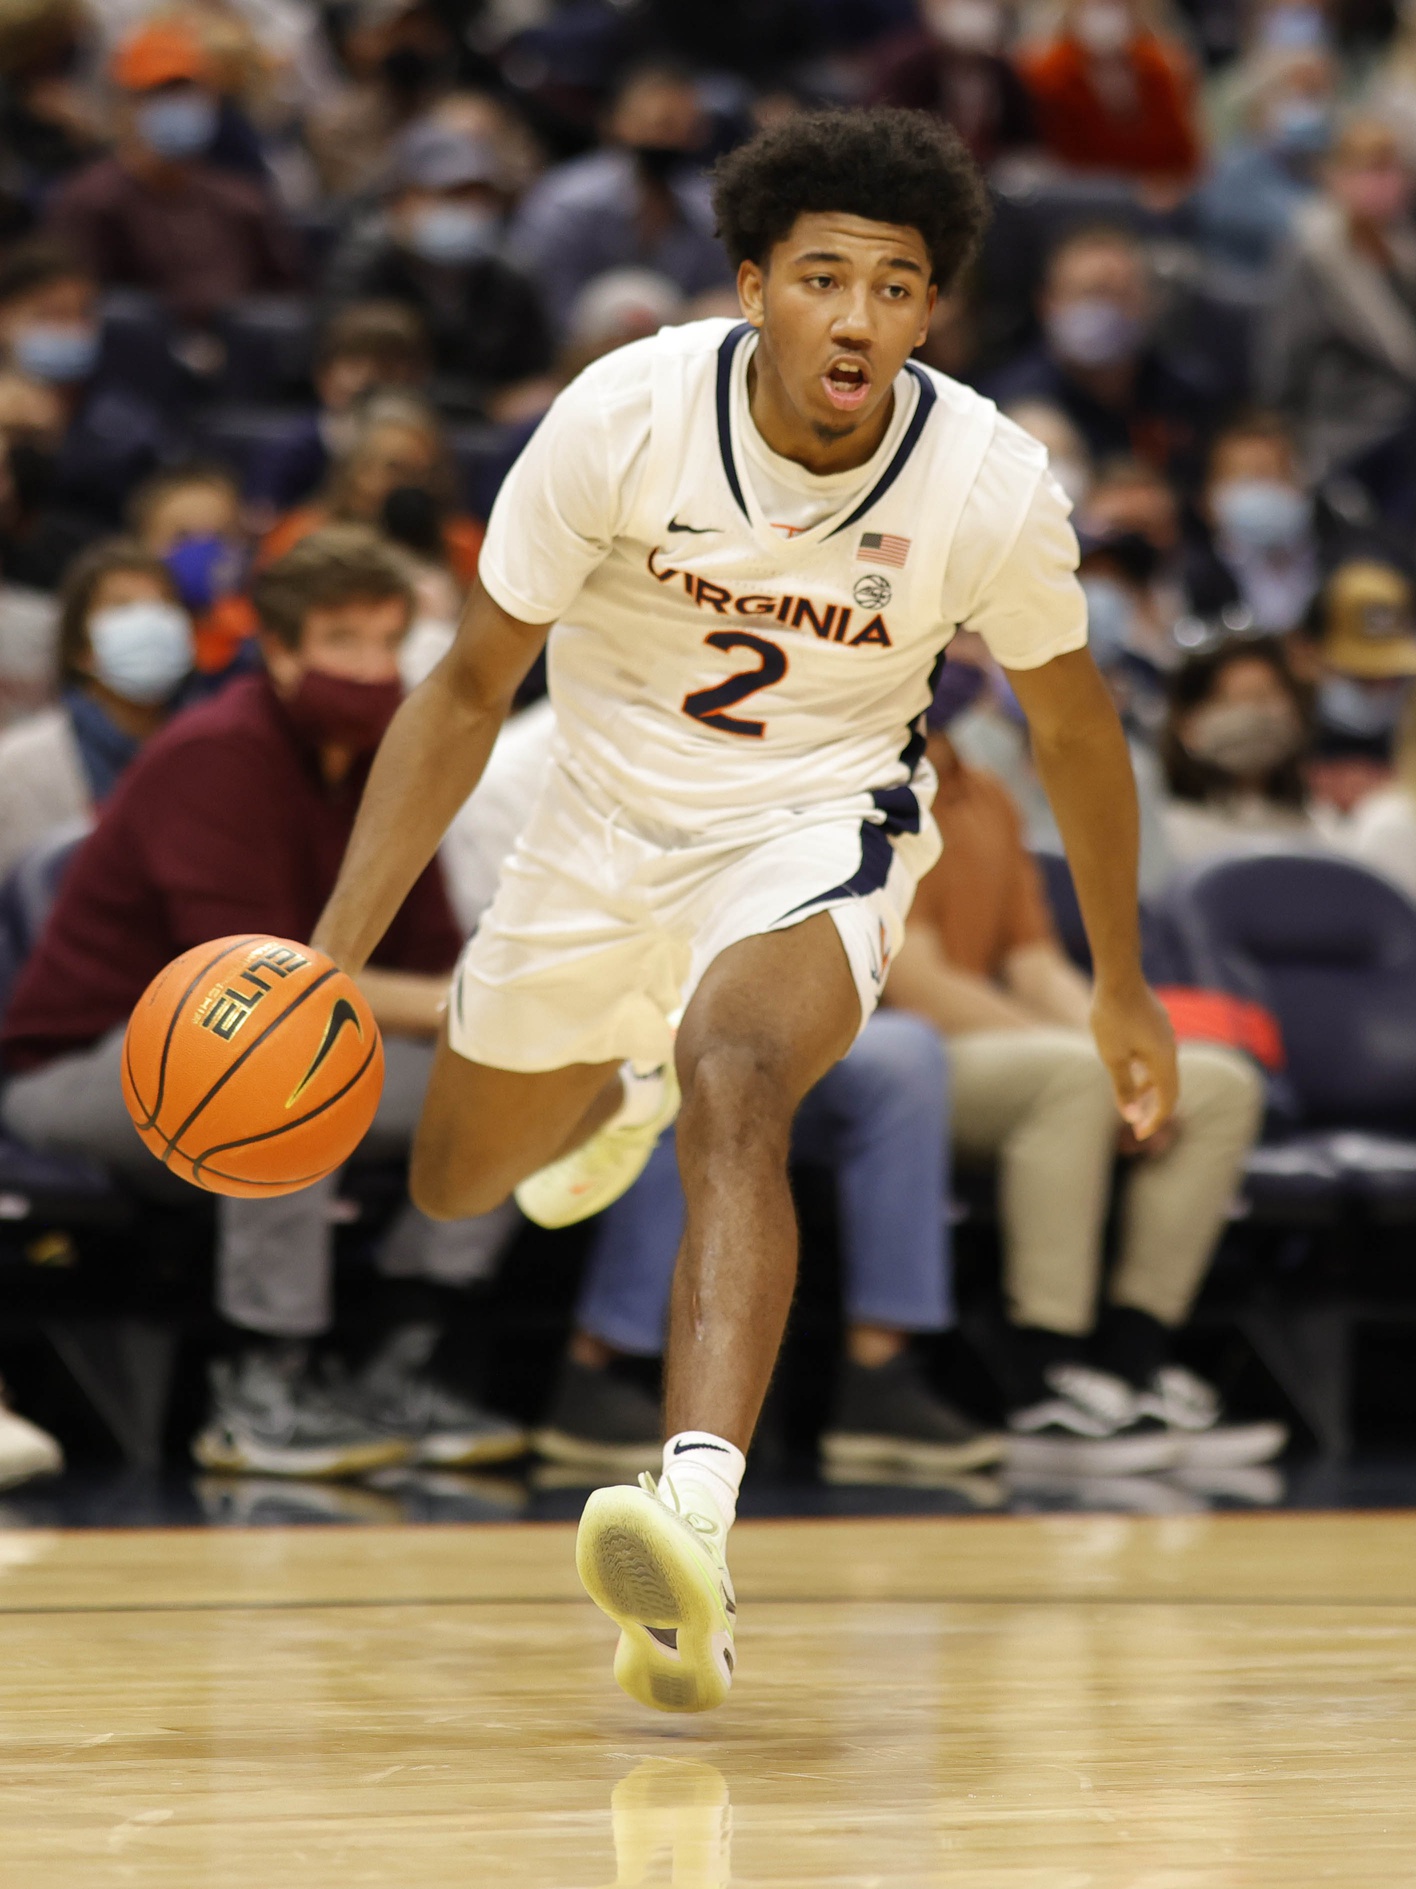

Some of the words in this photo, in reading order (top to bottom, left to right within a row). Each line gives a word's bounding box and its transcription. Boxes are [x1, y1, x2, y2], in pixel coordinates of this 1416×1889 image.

[647, 545, 893, 648] VIRGINIA
[681, 629, 789, 739] 2
[200, 945, 313, 1043] ELITE
